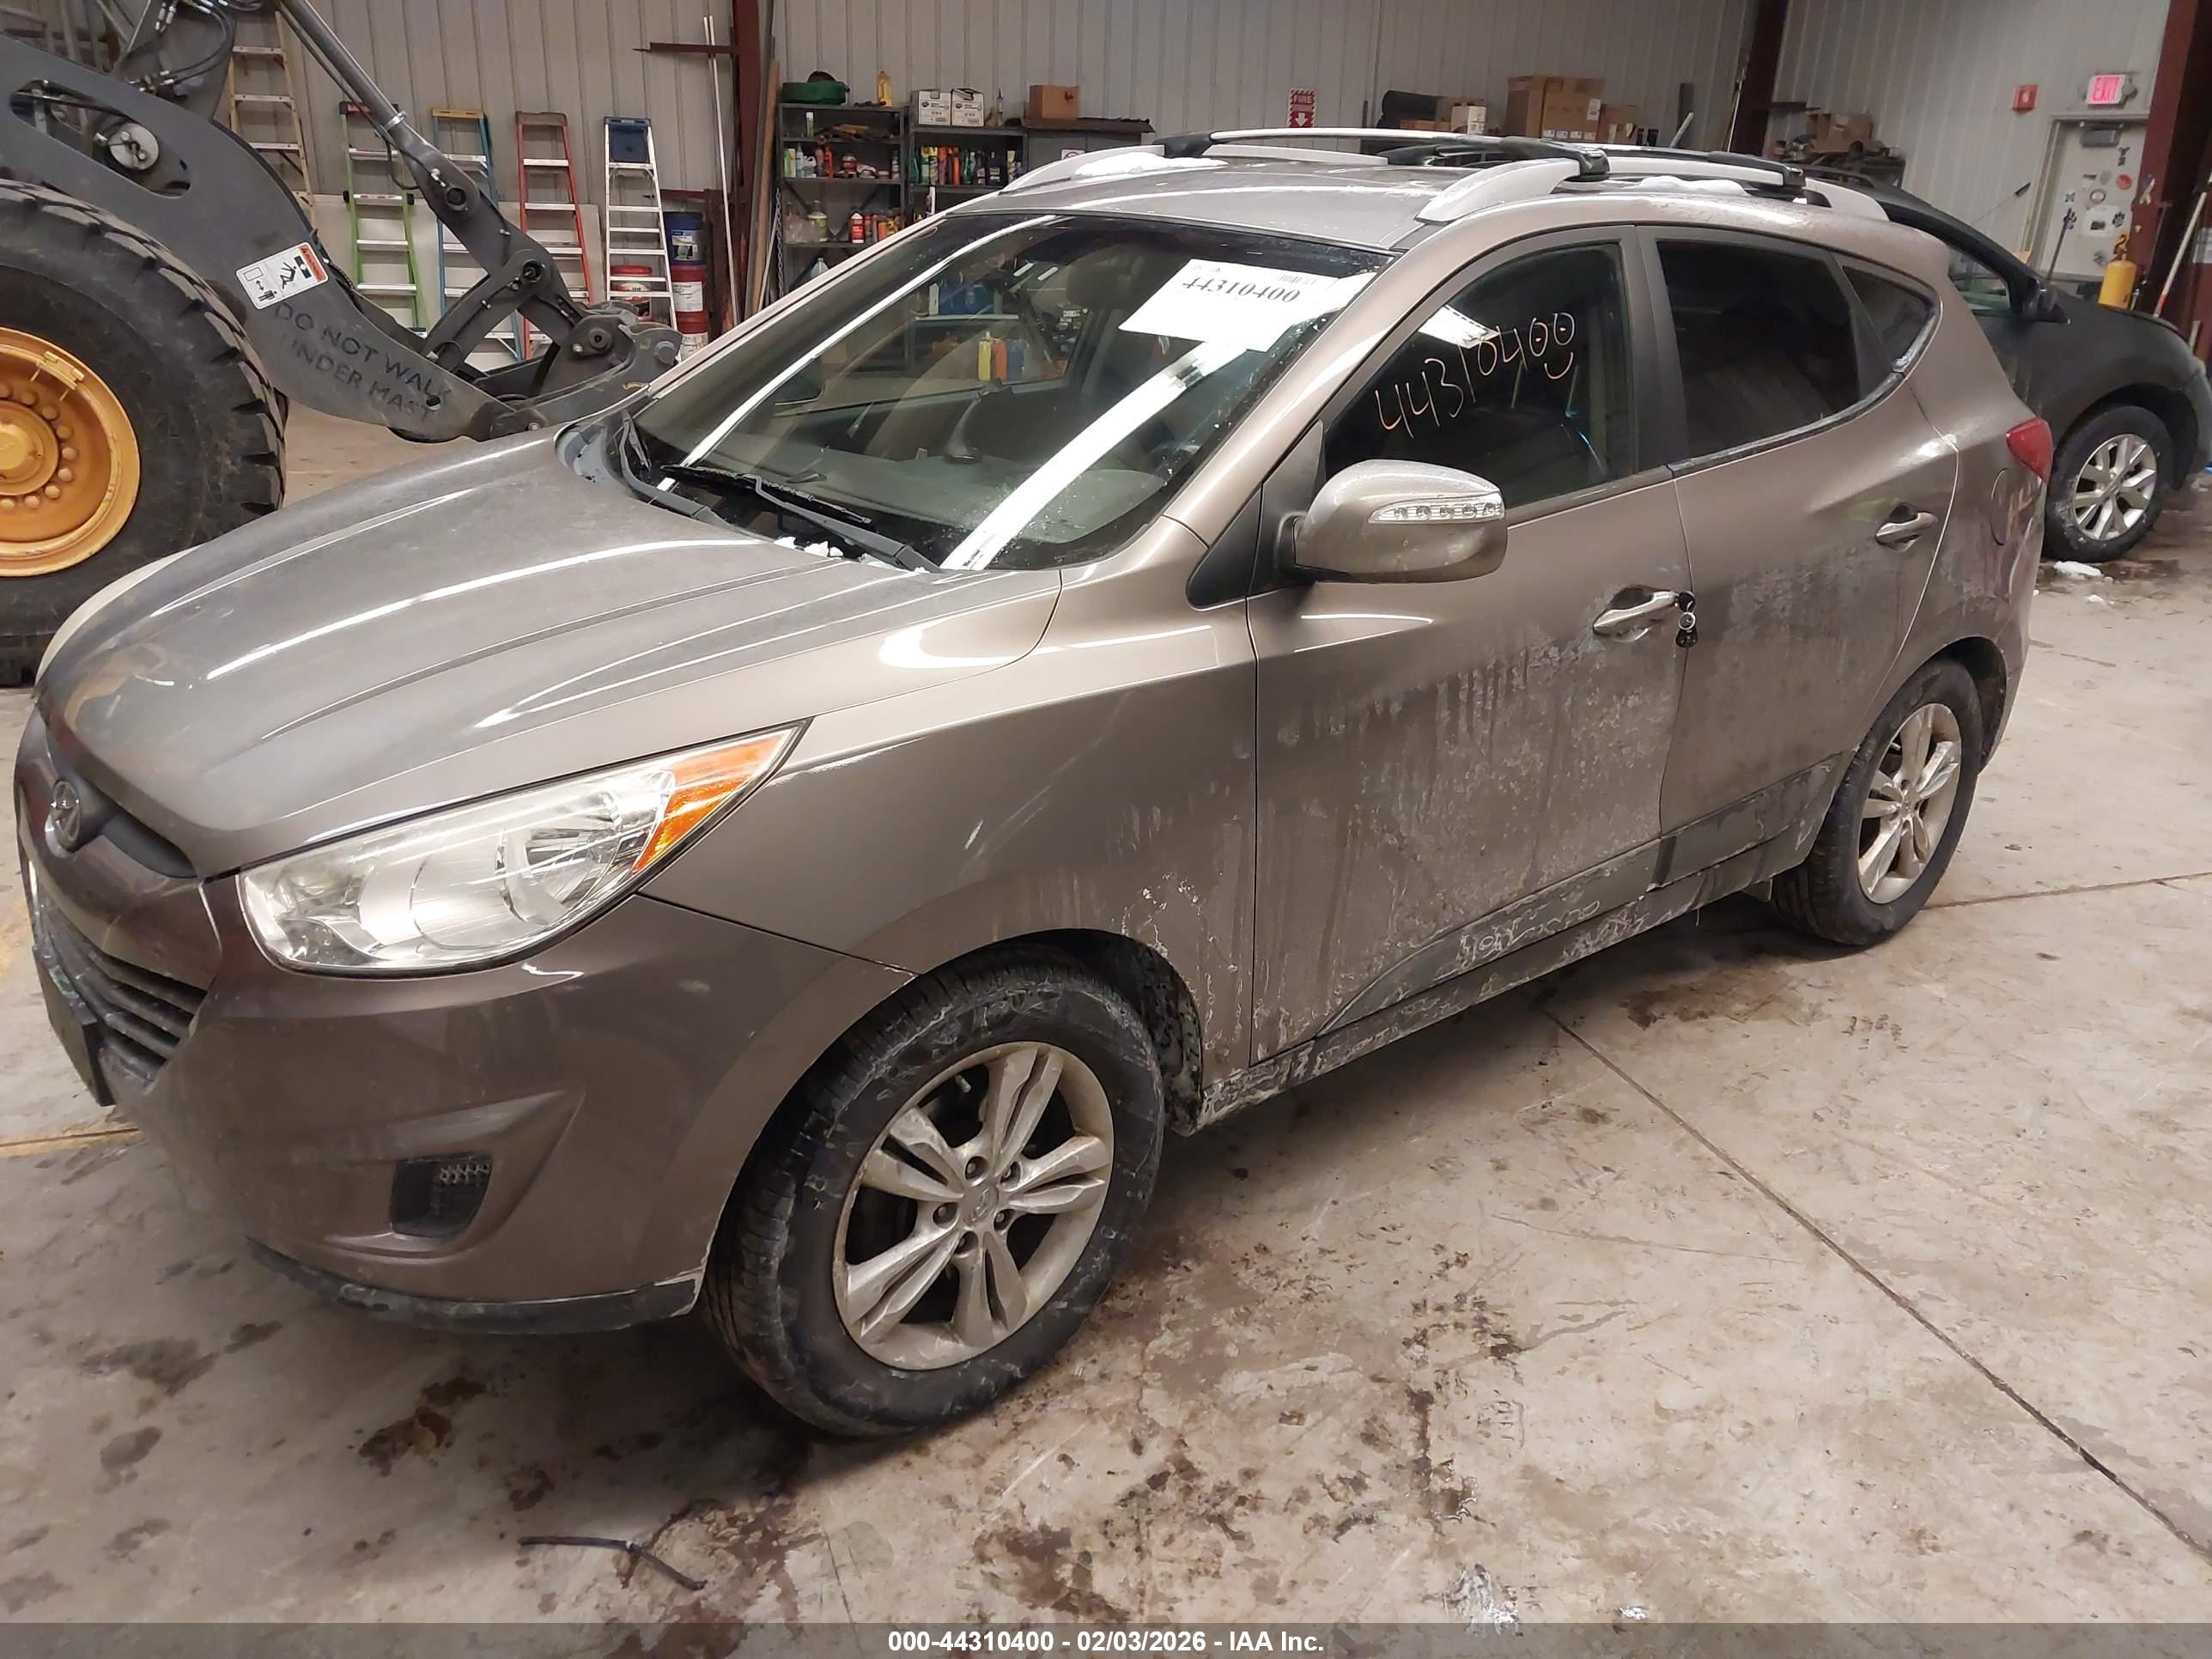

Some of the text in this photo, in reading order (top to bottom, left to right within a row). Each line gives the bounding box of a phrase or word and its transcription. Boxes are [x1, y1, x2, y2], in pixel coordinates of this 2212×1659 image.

[1293, 94, 1313, 104] FIRE
[1182, 276, 1301, 303] 44310400
[276, 302, 453, 405] DO NOT WALK
[1374, 312, 1576, 439] 44310400
[369, 380, 432, 422] MAST
